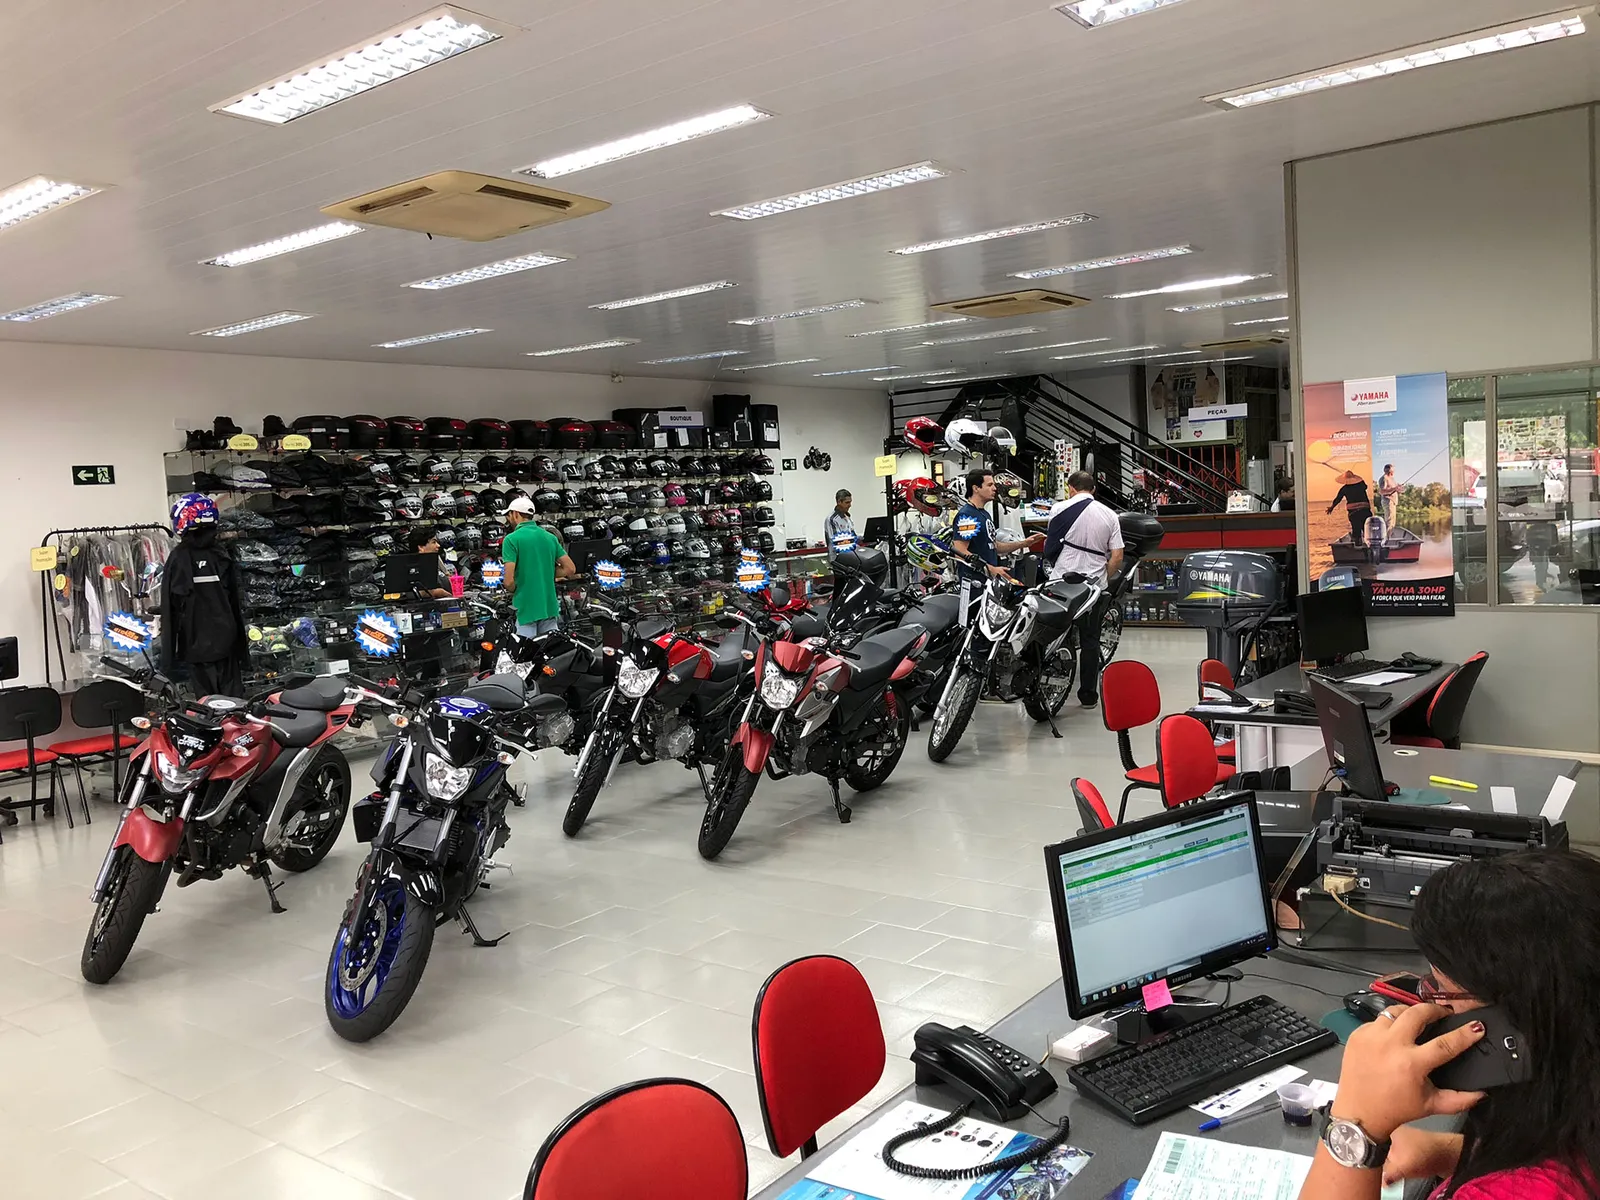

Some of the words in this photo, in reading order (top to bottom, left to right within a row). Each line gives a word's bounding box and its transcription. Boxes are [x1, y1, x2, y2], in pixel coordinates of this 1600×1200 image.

[1359, 391, 1389, 401] YAMAHA
[1198, 571, 1231, 583] YAMAHA
[1372, 586, 1415, 595] YAMAHA
[1417, 586, 1446, 595] 30HP
[178, 738, 205, 751] DRIVE
